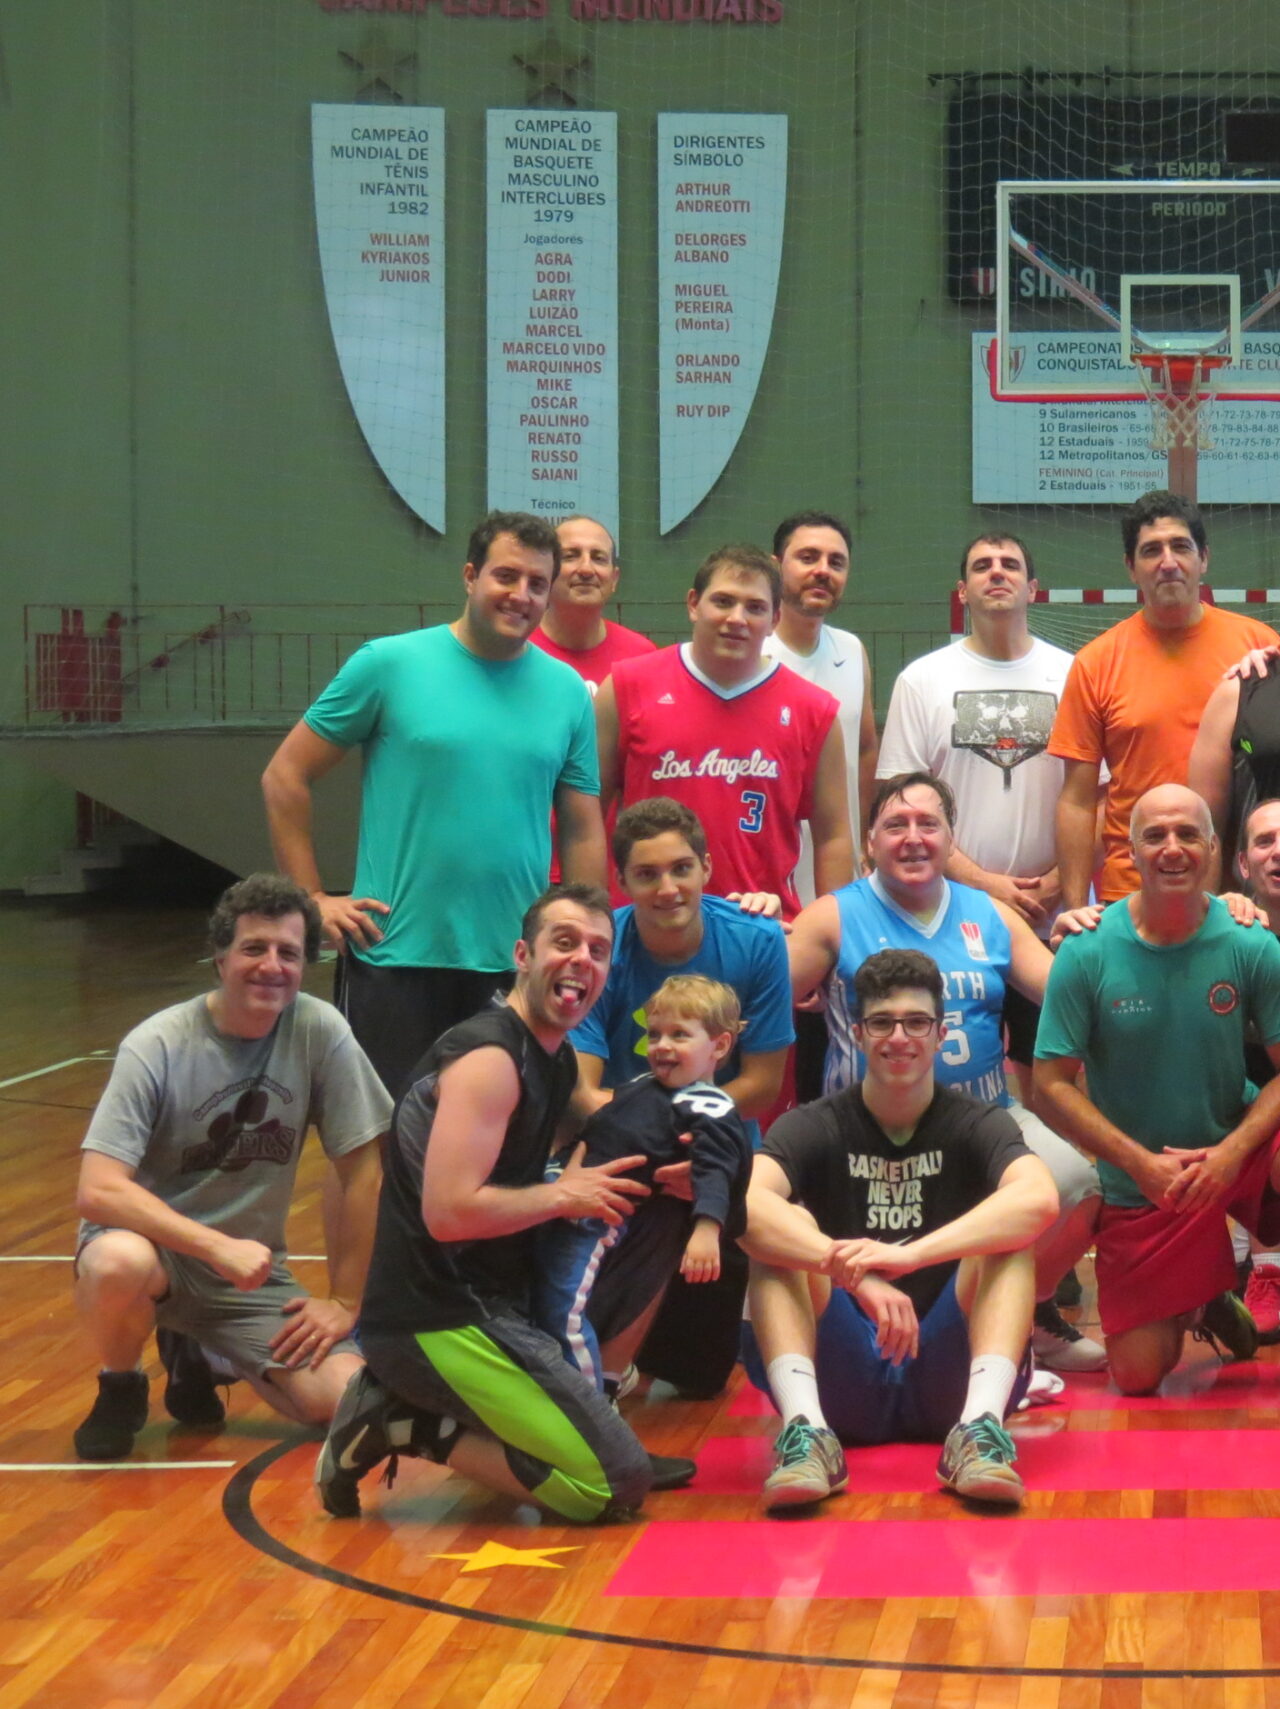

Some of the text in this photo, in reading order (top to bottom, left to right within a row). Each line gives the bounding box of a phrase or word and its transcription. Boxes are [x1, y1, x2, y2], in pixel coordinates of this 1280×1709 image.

[515, 118, 592, 133] CAMPEÃO
[351, 127, 429, 142] CAMPEÃO
[505, 137, 602, 152] MUNDIAL DE
[673, 135, 765, 149] DIRIGENTES
[331, 145, 429, 161] MUNDIAL DE
[673, 150, 744, 167] SÍMBOLO
[514, 155, 593, 171] BASQUETE
[1154, 161, 1221, 177] TEMPO
[385, 163, 429, 179] TÊNIS
[508, 173, 599, 187] MASCULINO
[360, 183, 429, 197] INFANTIL
[675, 183, 731, 196] ARTHUR
[501, 191, 606, 205] INTERCLUBES
[388, 202, 429, 215] 1982
[675, 200, 751, 213] ANDREOTTI
[534, 209, 574, 222] 1979
[370, 233, 430, 247] WILLIAM
[523, 233, 583, 246] Jogadores
[674, 233, 747, 246] DELORGES
[361, 251, 430, 265] KYRIAKOS
[535, 252, 573, 265] AGRA
[674, 250, 729, 263] ALBANO
[379, 269, 430, 283] JUNIOR
[536, 271, 570, 283] DODI
[532, 289, 576, 301] LARRY
[674, 284, 729, 297] MIGUEL
[675, 301, 733, 314] PEREIRA
[526, 324, 582, 337] MARCEL
[675, 318, 730, 333] (Monta)
[502, 342, 605, 356] MARCELO VIDO
[1037, 342, 1143, 354] CAMPEONATS
[675, 354, 740, 367] ORLANDO
[506, 360, 602, 375] MARQUINHOS
[675, 371, 732, 384] SARHAN
[537, 379, 573, 391] MIKE
[531, 396, 578, 409] OSCAR
[676, 405, 730, 418] RUY DIP
[1039, 410, 1047, 419] 9
[1050, 409, 1137, 419] Sulamericanos
[520, 414, 589, 427] PAULINHO
[1040, 423, 1055, 433] 10
[1058, 422, 1119, 433] Brasileiros
[528, 432, 582, 445] RENATO
[1039, 437, 1055, 447] 12
[1058, 436, 1114, 447] Estaduais
[531, 450, 578, 463] RUSSO
[1039, 451, 1055, 460] 12
[531, 468, 578, 481] SAIANI
[1039, 468, 1093, 478] FEMININO
[1120, 469, 1164, 479] Principal)
[1039, 481, 1047, 490] 2
[1050, 480, 1107, 490] Estaduais
[652, 748, 779, 785] Los Angeles
[739, 790, 766, 834] 3
[942, 971, 986, 1000] RTH
[867, 1179, 924, 1206] NEVER
[866, 1204, 923, 1230] STOPS
